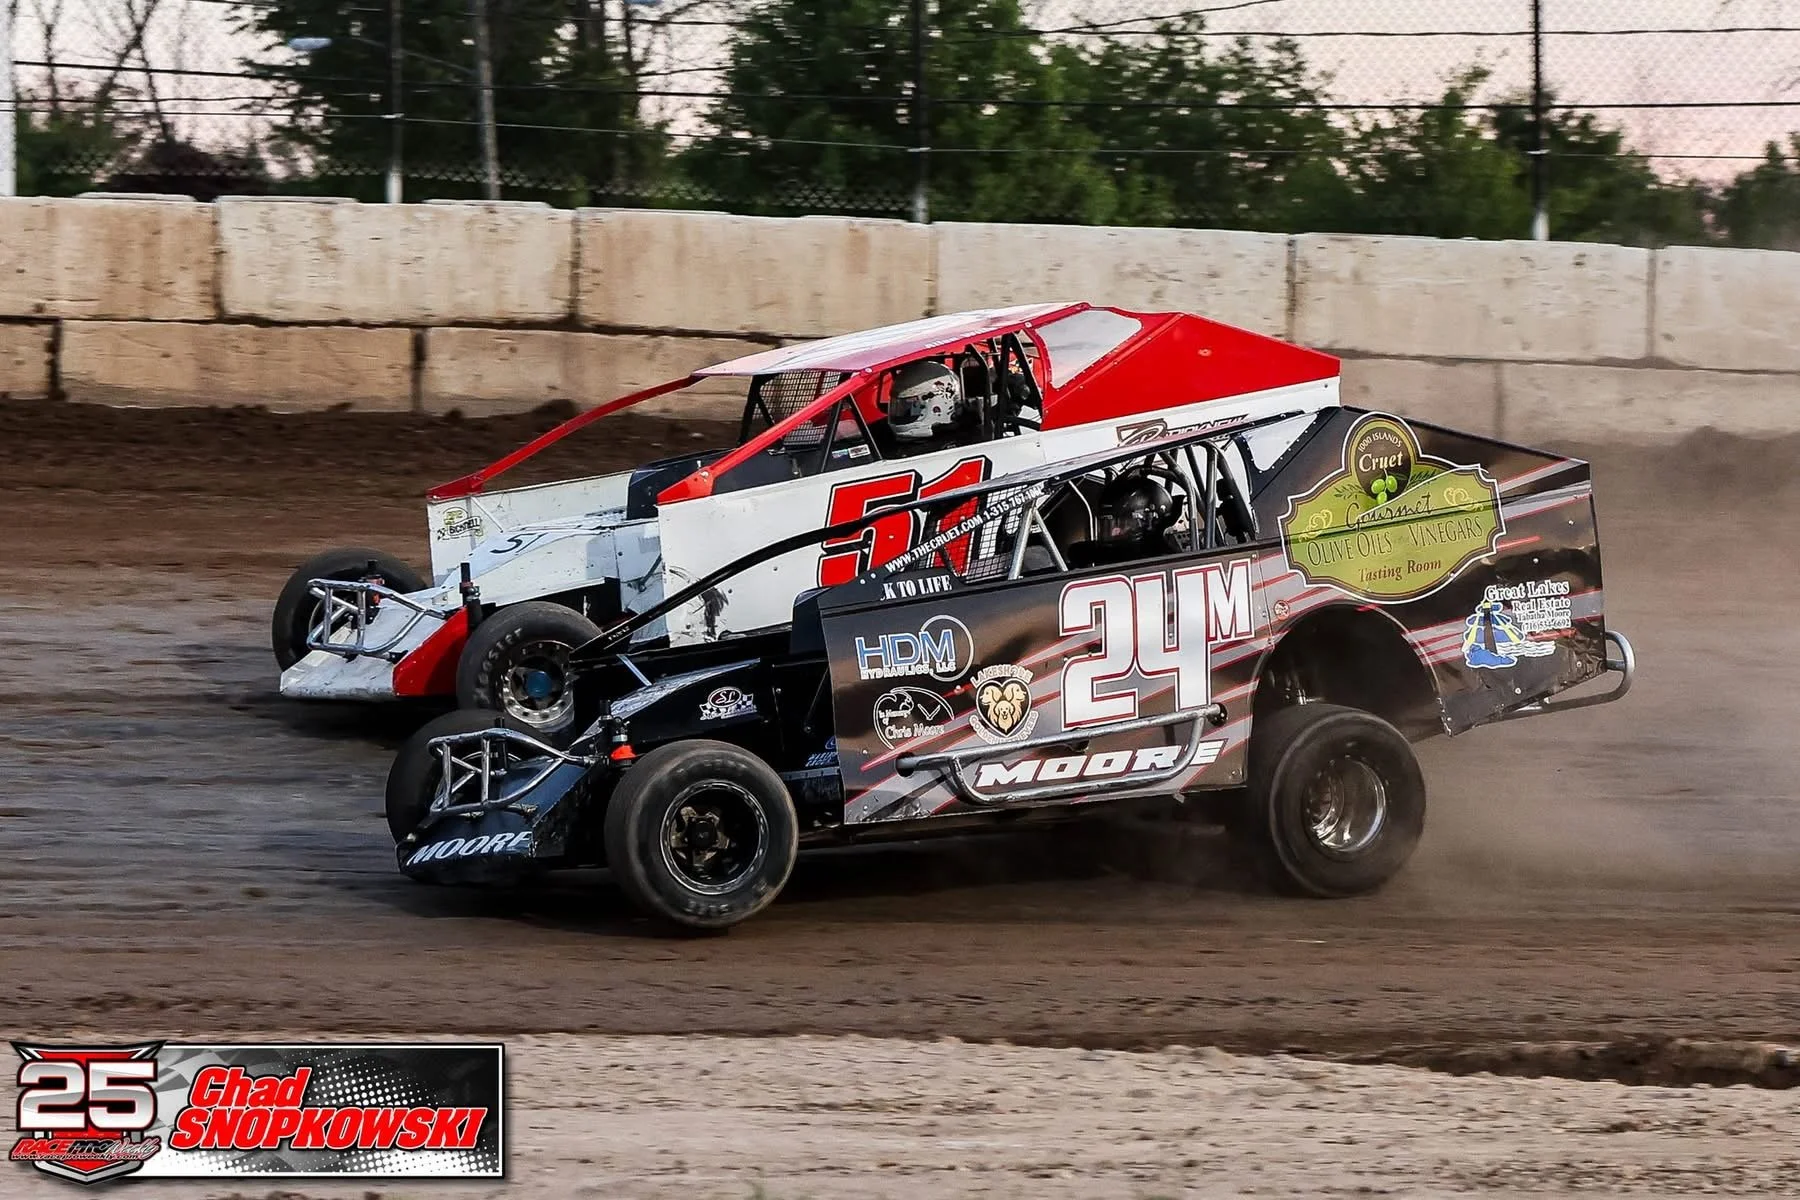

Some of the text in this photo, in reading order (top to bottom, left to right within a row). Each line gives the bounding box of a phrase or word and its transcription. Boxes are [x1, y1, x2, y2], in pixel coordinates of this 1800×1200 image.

[1372, 431, 1403, 448] ISLANDS
[1358, 450, 1404, 472] Cruet
[818, 455, 993, 589] 51
[1346, 494, 1434, 531] Gourmet
[885, 516, 984, 573] WWW.THECRUET.COM
[1307, 515, 1484, 566] OLIVE OILS VINEGARS
[1358, 558, 1442, 582] Tasting Room
[897, 579, 917, 598] TO
[917, 575, 952, 596] LIFE
[1485, 579, 1570, 601] Great Lakes
[1512, 597, 1571, 612] Real Estate
[855, 628, 956, 669] HDM
[935, 662, 957, 673] LLC
[970, 664, 1033, 688] LAKESHORE
[885, 722, 912, 740] Chris
[969, 714, 999, 745] GOLDEN
[973, 738, 1228, 789] MOORE
